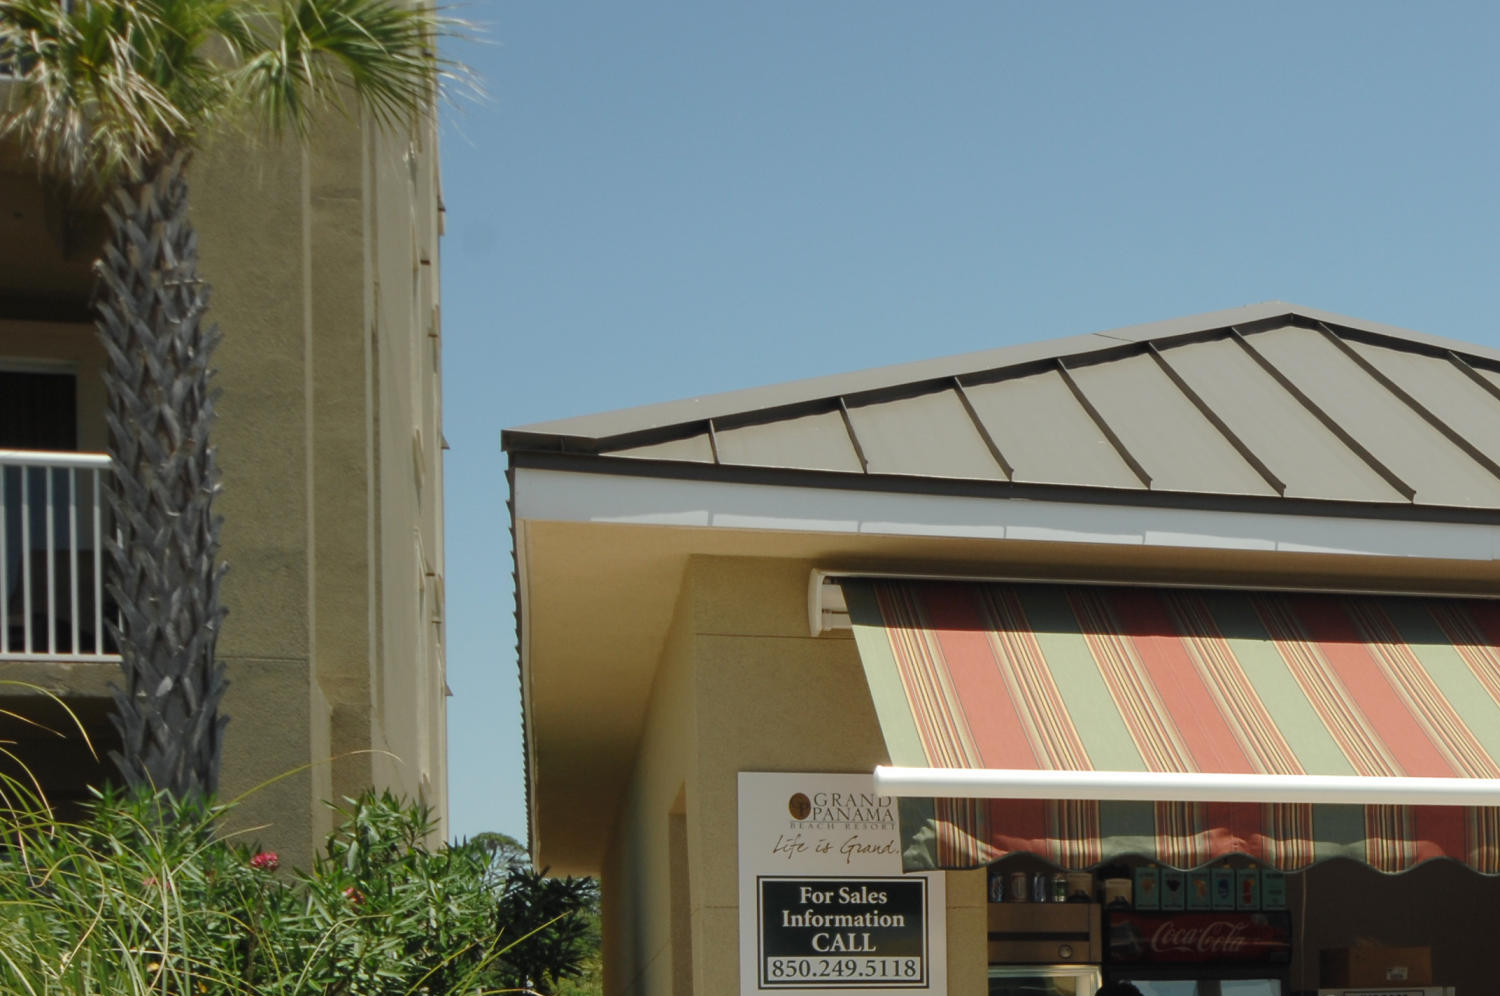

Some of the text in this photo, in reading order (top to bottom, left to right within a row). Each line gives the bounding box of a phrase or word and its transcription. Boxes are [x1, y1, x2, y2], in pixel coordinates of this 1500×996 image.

[813, 792, 893, 808] GRAND
[812, 806, 895, 822] PANAMA
[789, 823, 896, 831] BEACH RESORT
[772, 833, 900, 864] Life is Grand.
[799, 886, 888, 905] For Sales
[781, 909, 906, 928] Information
[811, 932, 877, 953] CALL
[771, 959, 917, 979] 850.249.5118
